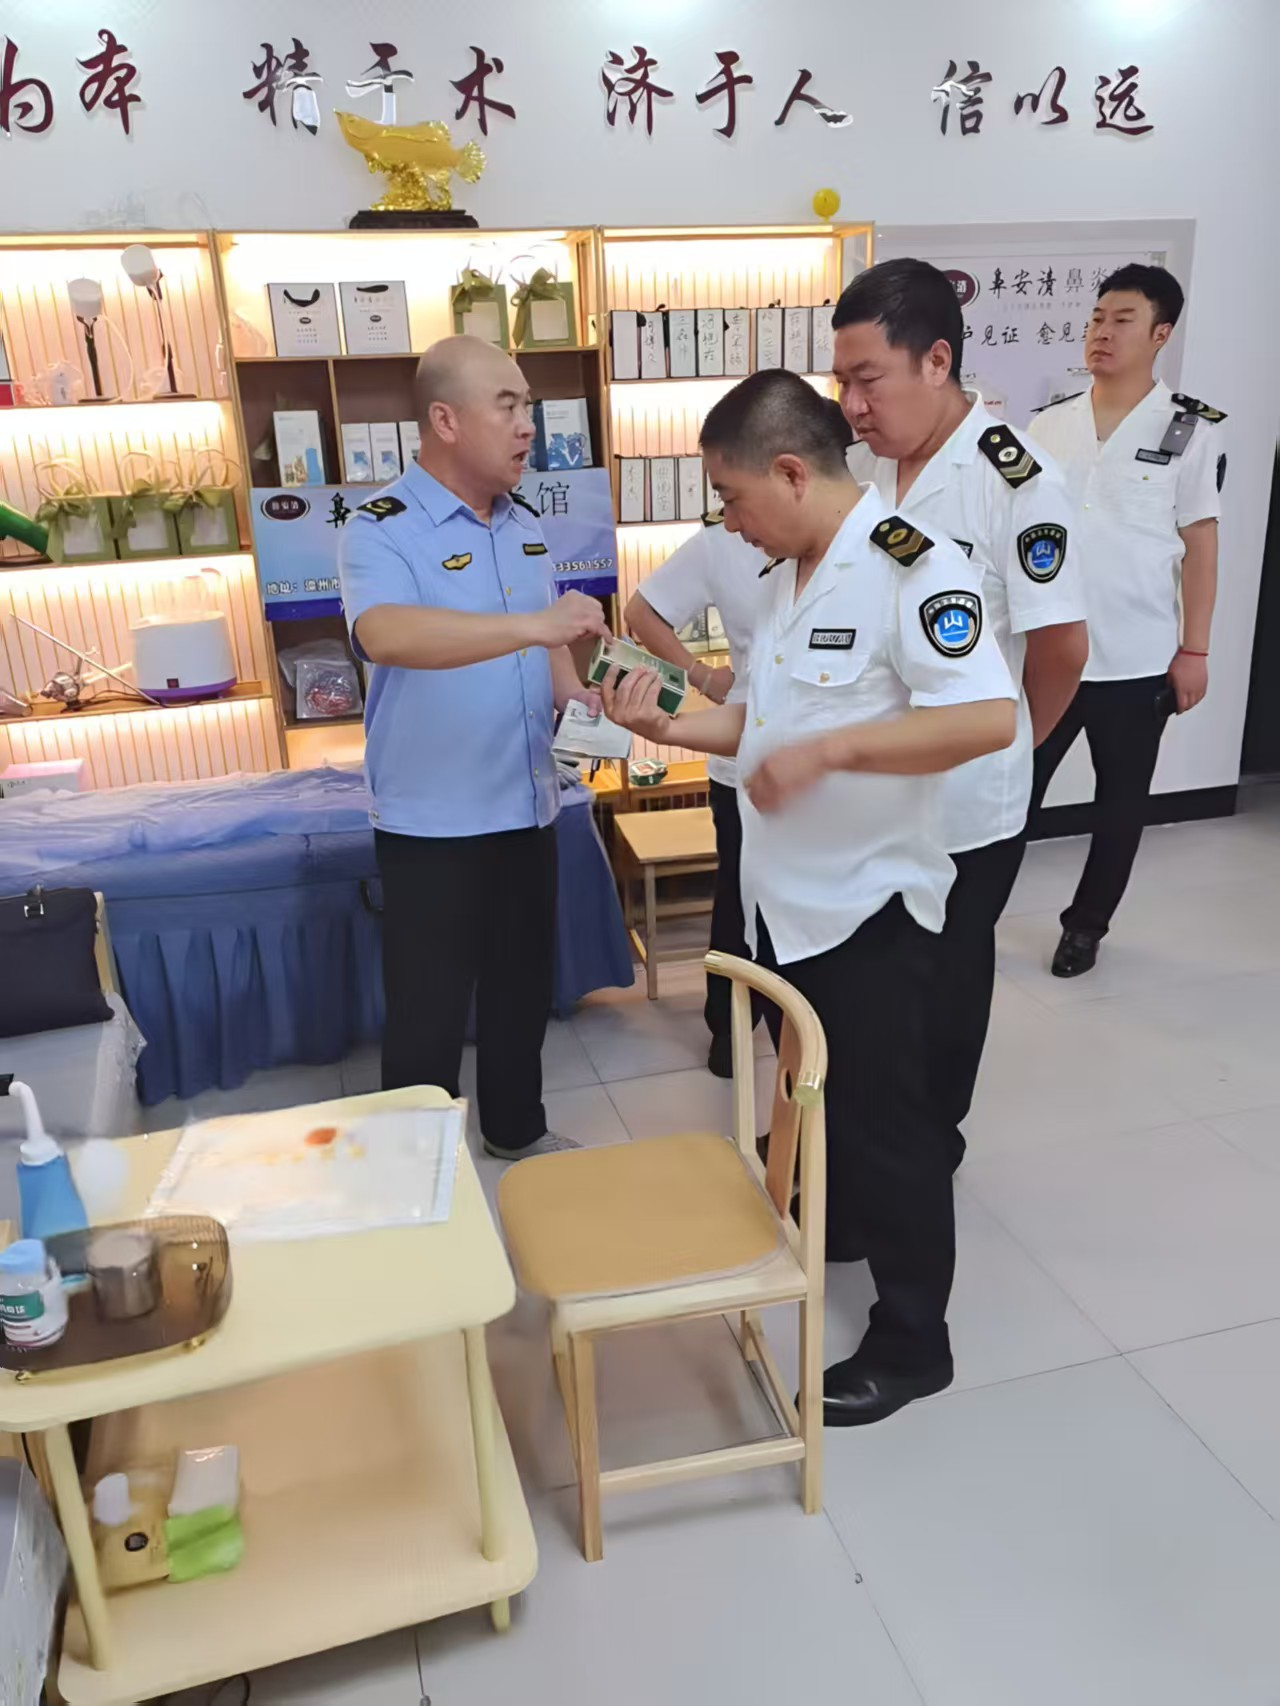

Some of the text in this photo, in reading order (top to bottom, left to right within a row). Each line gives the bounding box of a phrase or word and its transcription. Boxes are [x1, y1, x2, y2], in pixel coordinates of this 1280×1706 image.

[602, 45, 854, 138] 济于人
[931, 59, 1154, 136] 信以远
